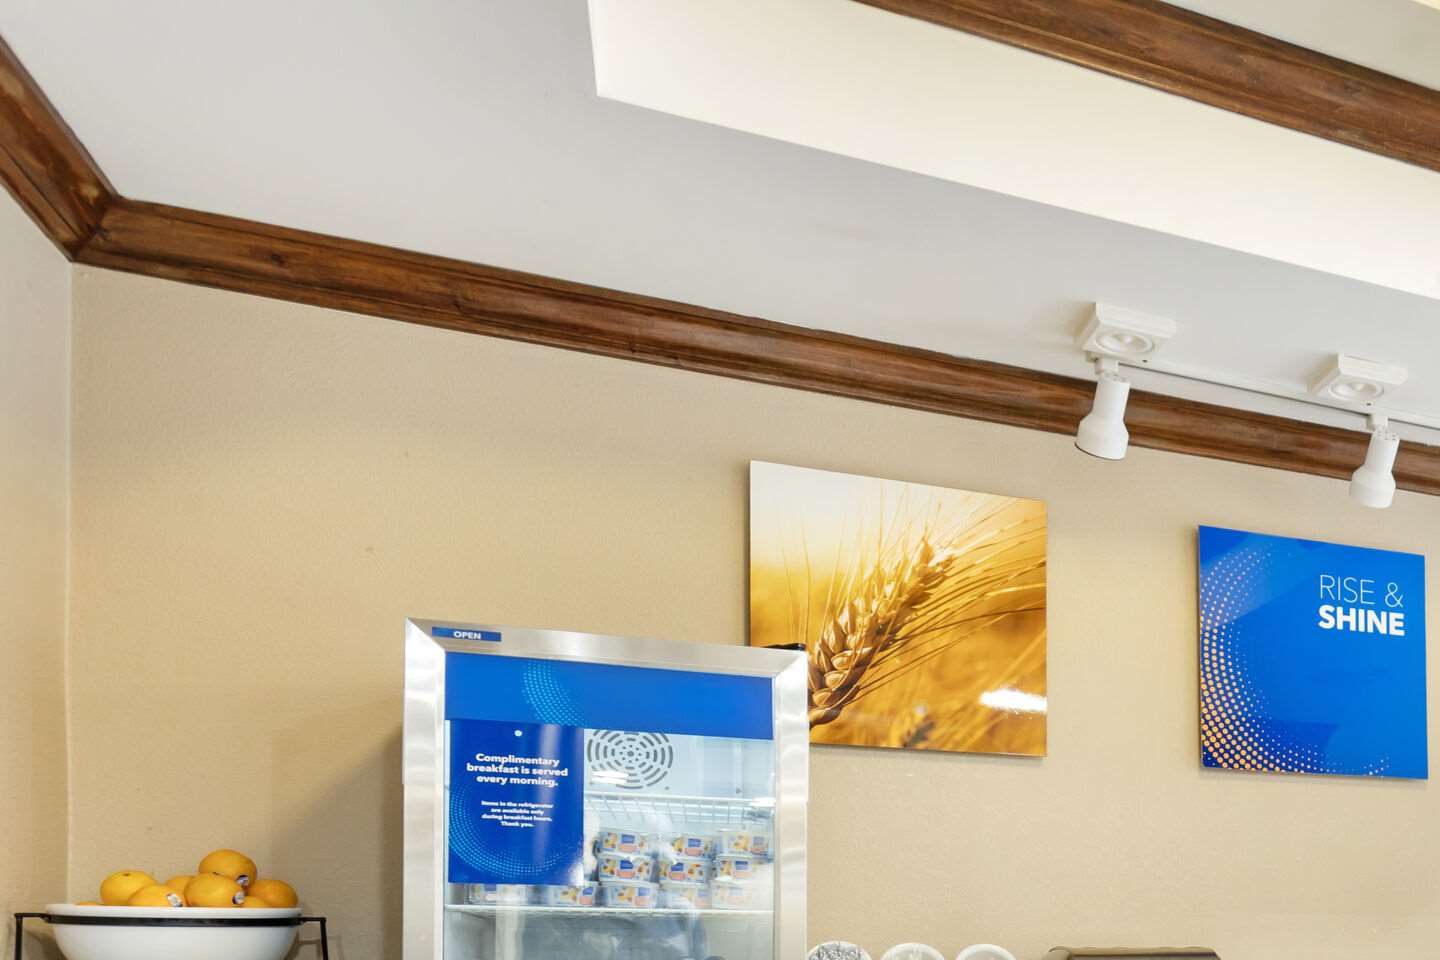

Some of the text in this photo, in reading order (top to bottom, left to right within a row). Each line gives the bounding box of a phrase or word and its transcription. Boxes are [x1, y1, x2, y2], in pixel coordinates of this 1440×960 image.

[1319, 574, 1404, 608] RISE &
[1318, 604, 1405, 636] SHINE
[453, 630, 482, 640] OPEN
[475, 753, 560, 767] Complimentary
[466, 762, 569, 777] breakfast is served
[476, 776, 559, 788] every morning.
